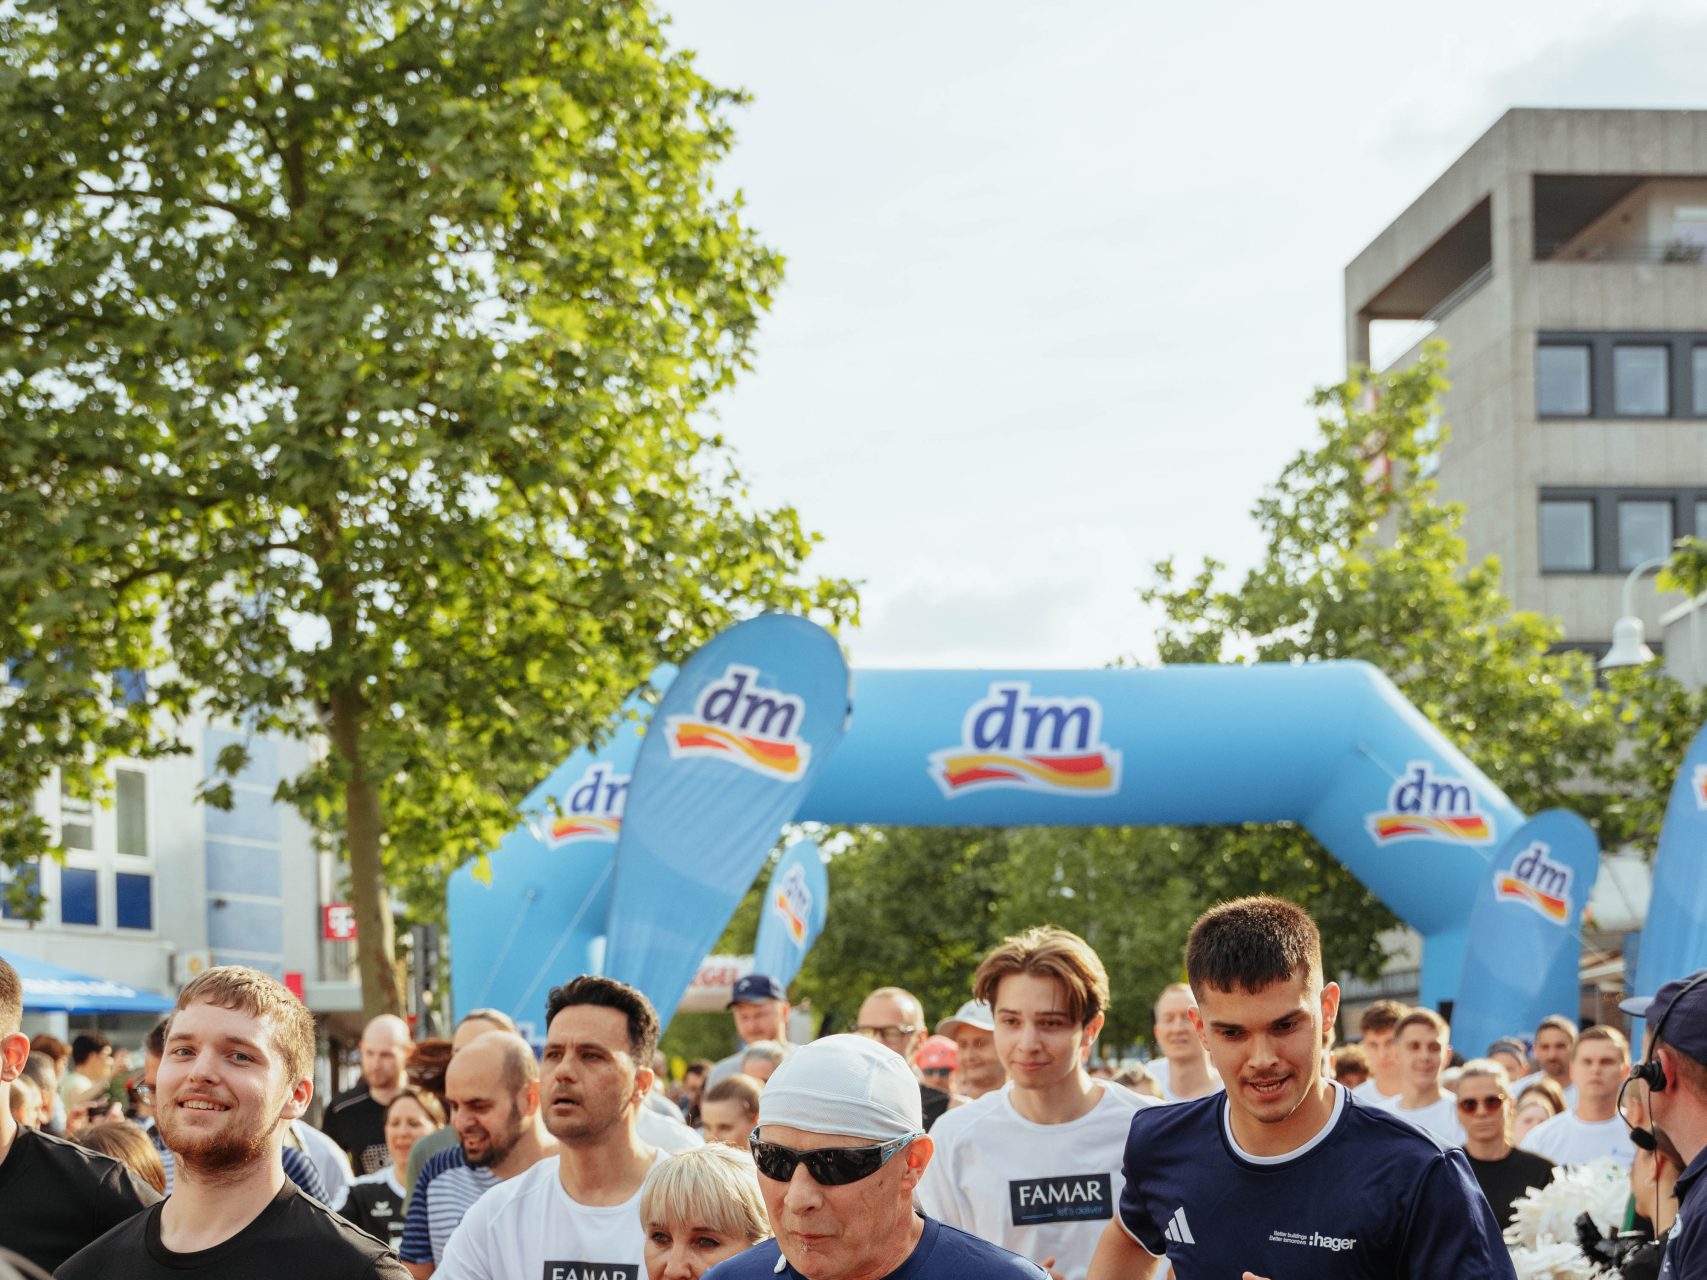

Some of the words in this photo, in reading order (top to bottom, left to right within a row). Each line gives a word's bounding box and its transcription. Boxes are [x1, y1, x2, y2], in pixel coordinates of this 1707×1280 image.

[703, 673, 796, 738] dm
[973, 690, 1091, 751] dm
[1395, 768, 1470, 814] dm
[1515, 849, 1567, 896] dm
[1019, 1181, 1102, 1206] FAMAR
[1269, 1234, 1282, 1242] Better
[1283, 1237, 1307, 1245] tomorrows
[1288, 1232, 1307, 1240] buildings
